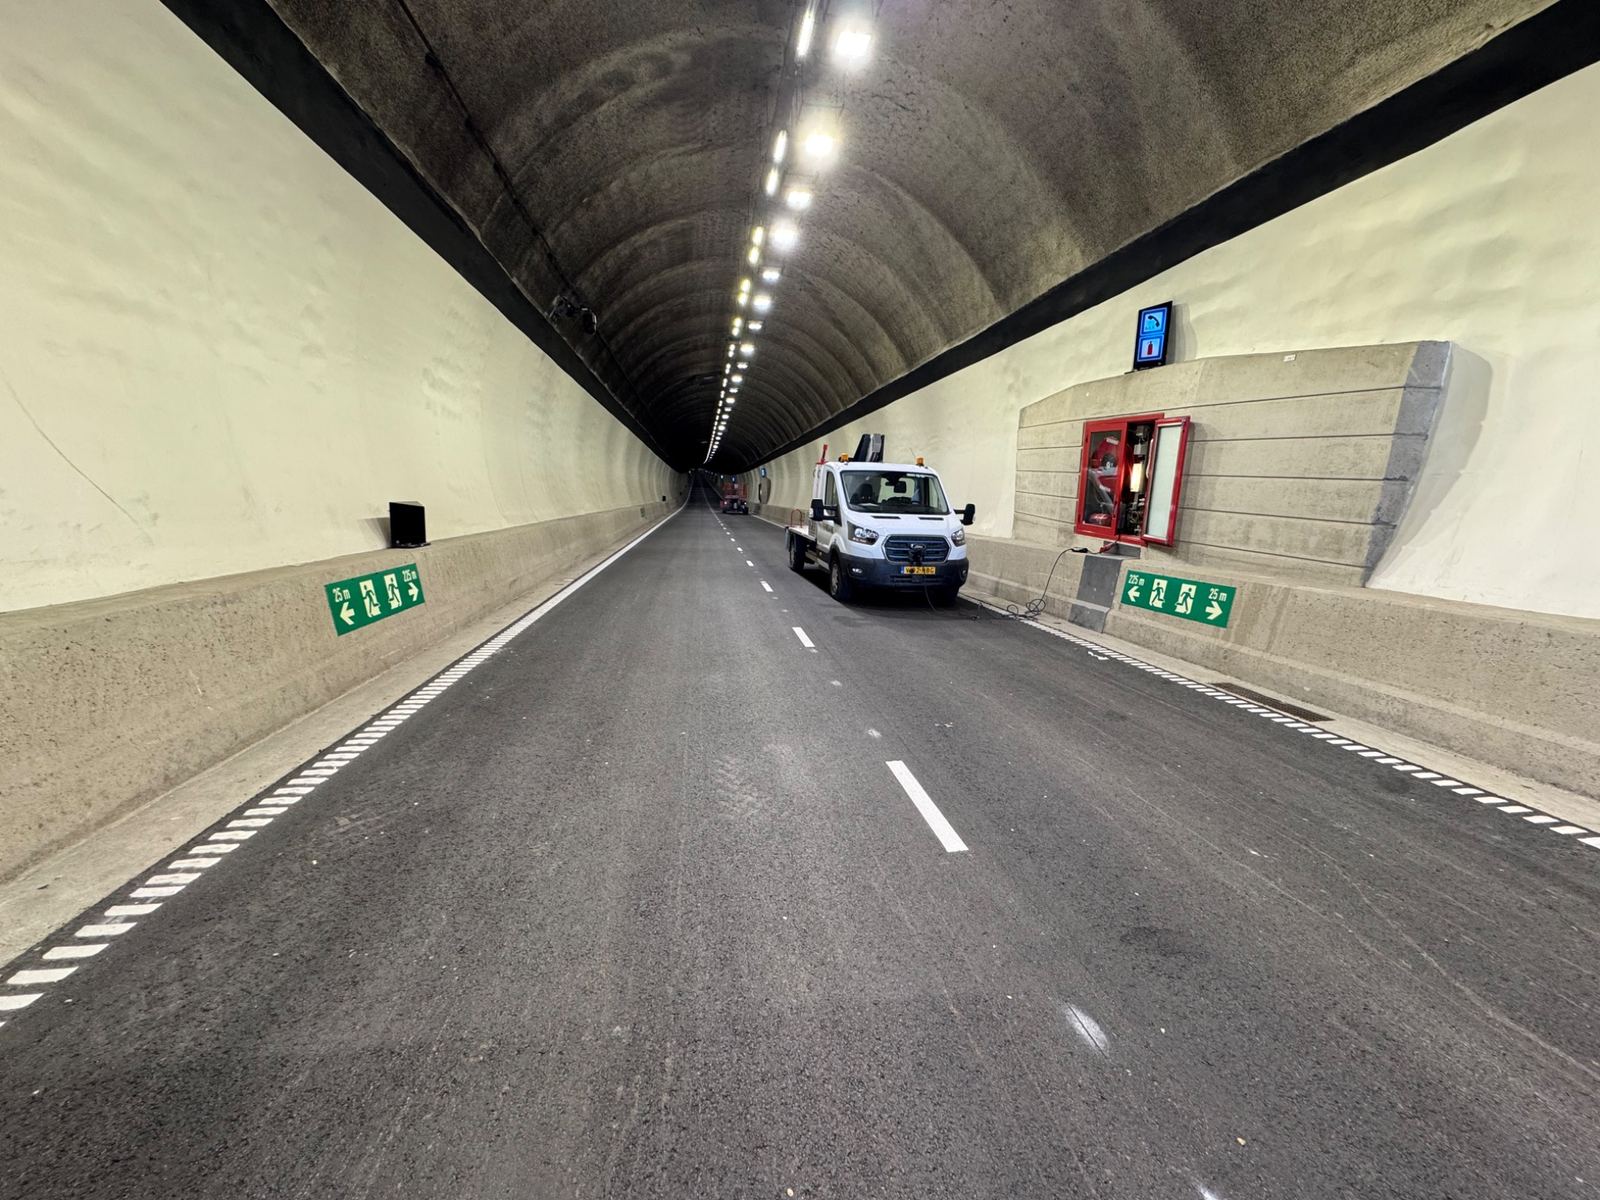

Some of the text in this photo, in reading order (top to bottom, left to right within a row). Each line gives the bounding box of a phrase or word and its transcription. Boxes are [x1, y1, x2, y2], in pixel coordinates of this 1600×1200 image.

[411, 571, 417, 580] m
[1128, 574, 1145, 586] 225 m
[332, 587, 351, 603] 25 m
[1208, 588, 1227, 602] 25 m
